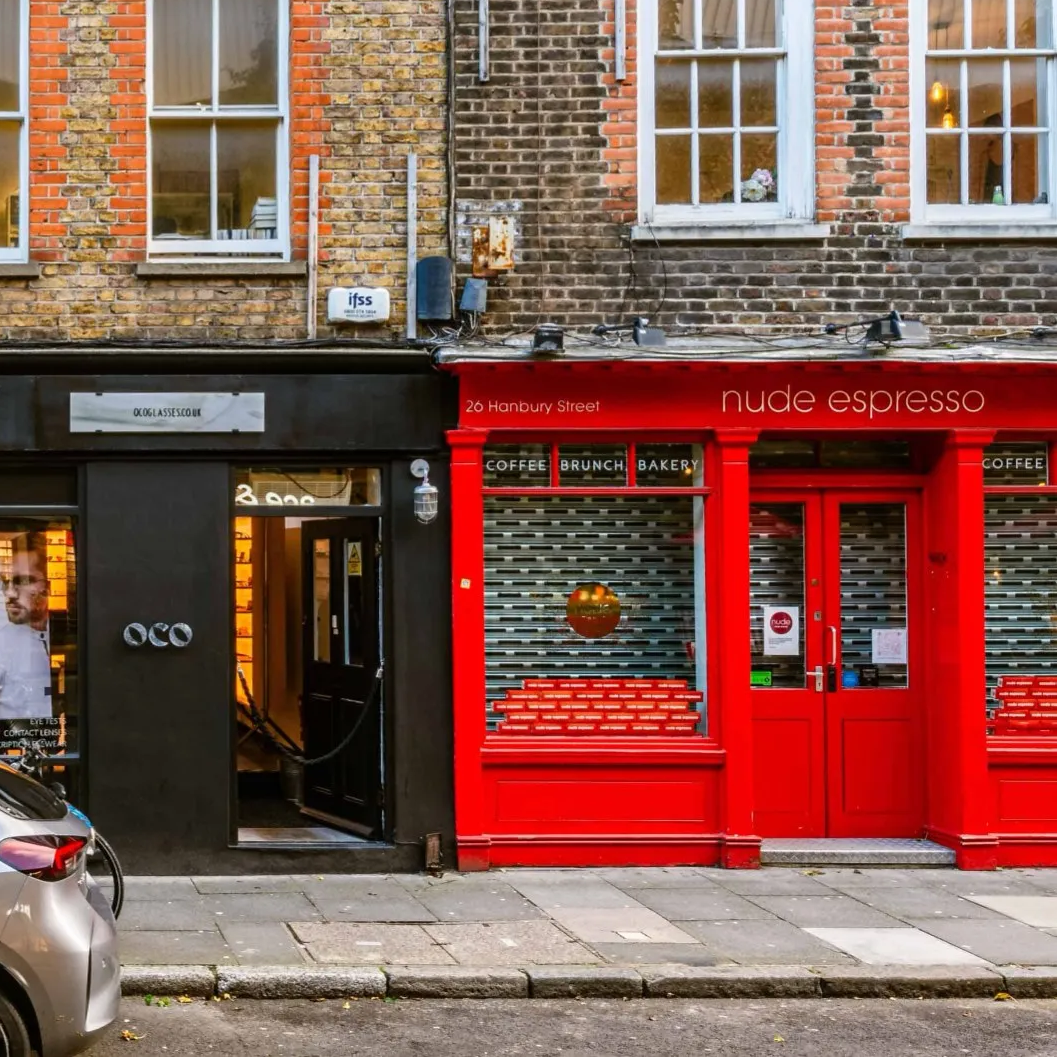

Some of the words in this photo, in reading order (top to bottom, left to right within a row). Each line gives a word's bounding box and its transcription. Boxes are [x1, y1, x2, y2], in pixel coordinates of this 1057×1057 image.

[348, 292, 373, 309] ifss
[465, 400, 483, 413] 26
[488, 400, 553, 414] Hanbury
[557, 400, 600, 413] Street
[722, 384, 816, 413] nude
[828, 390, 985, 419] espresso
[485, 459, 547, 472] COFFEE
[560, 459, 622, 471] BRUNCH
[637, 459, 699, 471] BAKERY
[981, 457, 1044, 470] COFFEE
[771, 617, 791, 626] nude
[29, 717, 43, 725] EYE
[45, 717, 67, 725] TESTS
[3, 729, 39, 737] CONTACT
[39, 728, 67, 736] LENSES
